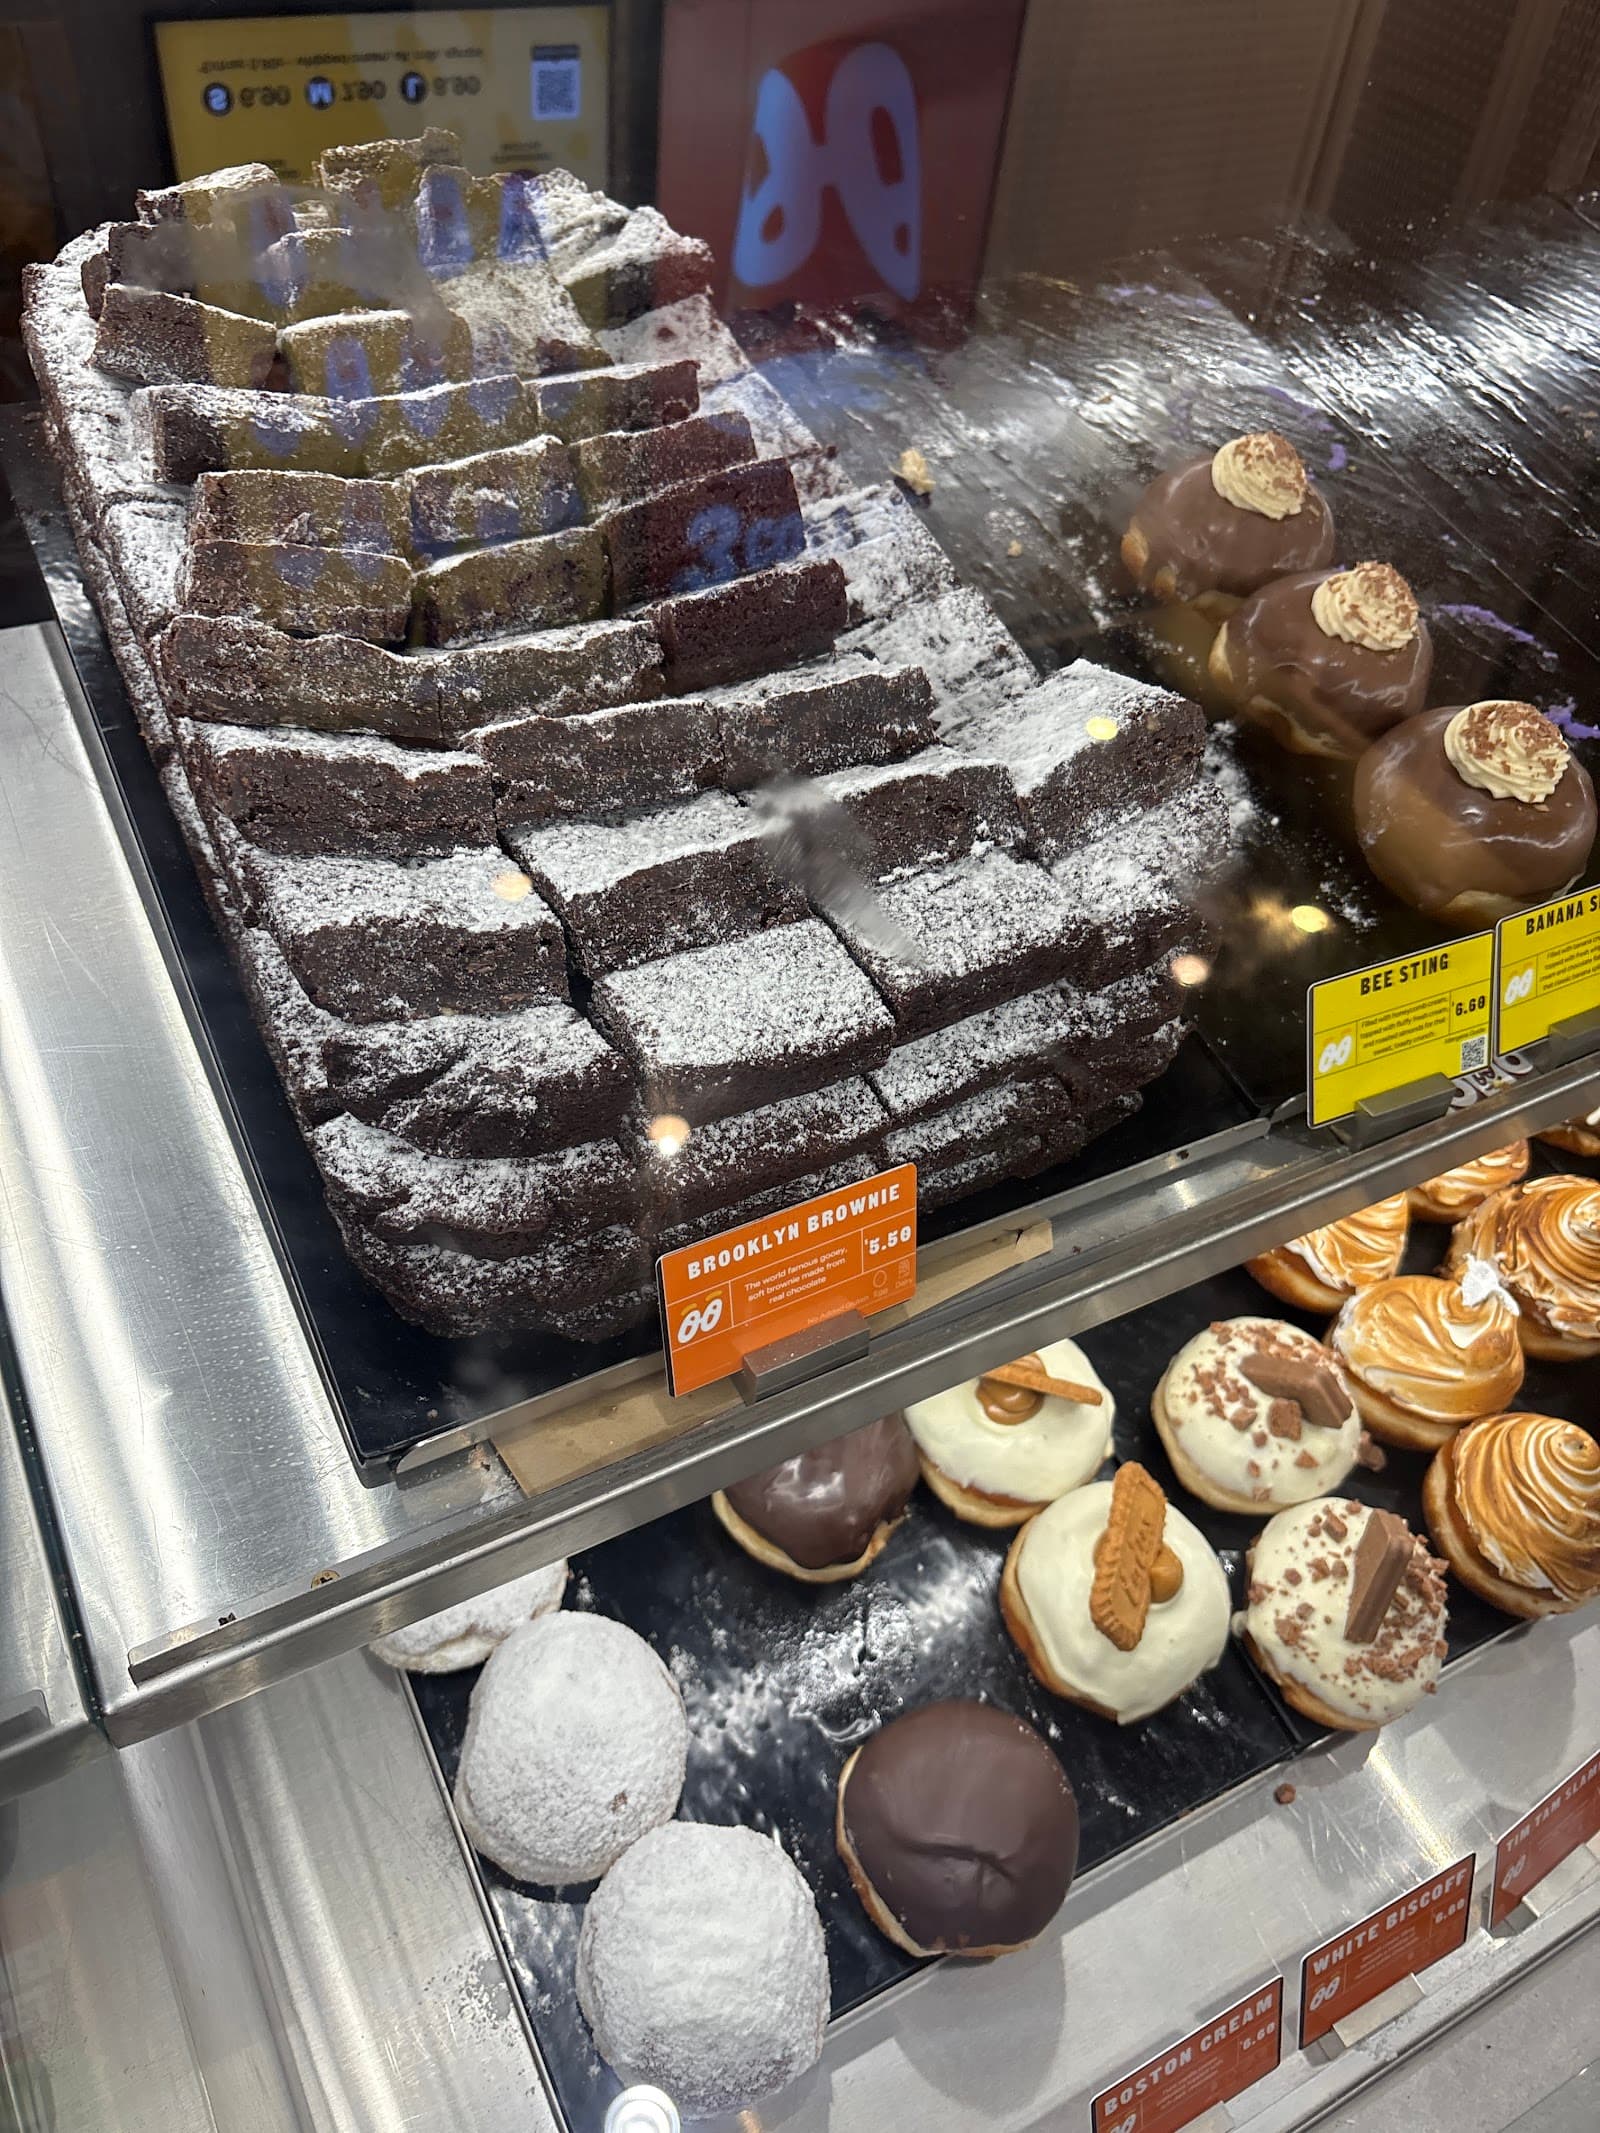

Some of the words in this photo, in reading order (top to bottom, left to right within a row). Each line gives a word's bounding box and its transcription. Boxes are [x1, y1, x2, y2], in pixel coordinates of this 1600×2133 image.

[1526, 899, 1583, 935] BANANA
[1590, 893, 1600, 912] S
[1360, 969, 1392, 995] BEE
[1399, 952, 1448, 983] STING
[687, 1221, 799, 1280] BROOKLYN
[807, 1182, 900, 1233] BROWNIE
[744, 1278, 761, 1292] The
[762, 1269, 786, 1285] world
[787, 1256, 818, 1275] famous
[748, 1288, 764, 1302] soft
[766, 1274, 800, 1294] brownie
[801, 1264, 824, 1280] made
[826, 1256, 845, 1270] from
[768, 1291, 785, 1304] real
[786, 1274, 826, 1297] chocolate
[1505, 1823, 1530, 1854] TIM
[1534, 1795, 1560, 1828] TAM
[1565, 1759, 1600, 1801] SLAM
[1313, 1921, 1379, 1977] WHITE
[1385, 1866, 1466, 1931] BISCOFF
[1104, 2045, 1192, 2118] BOSTON
[1200, 1991, 1272, 2054] CREAM
